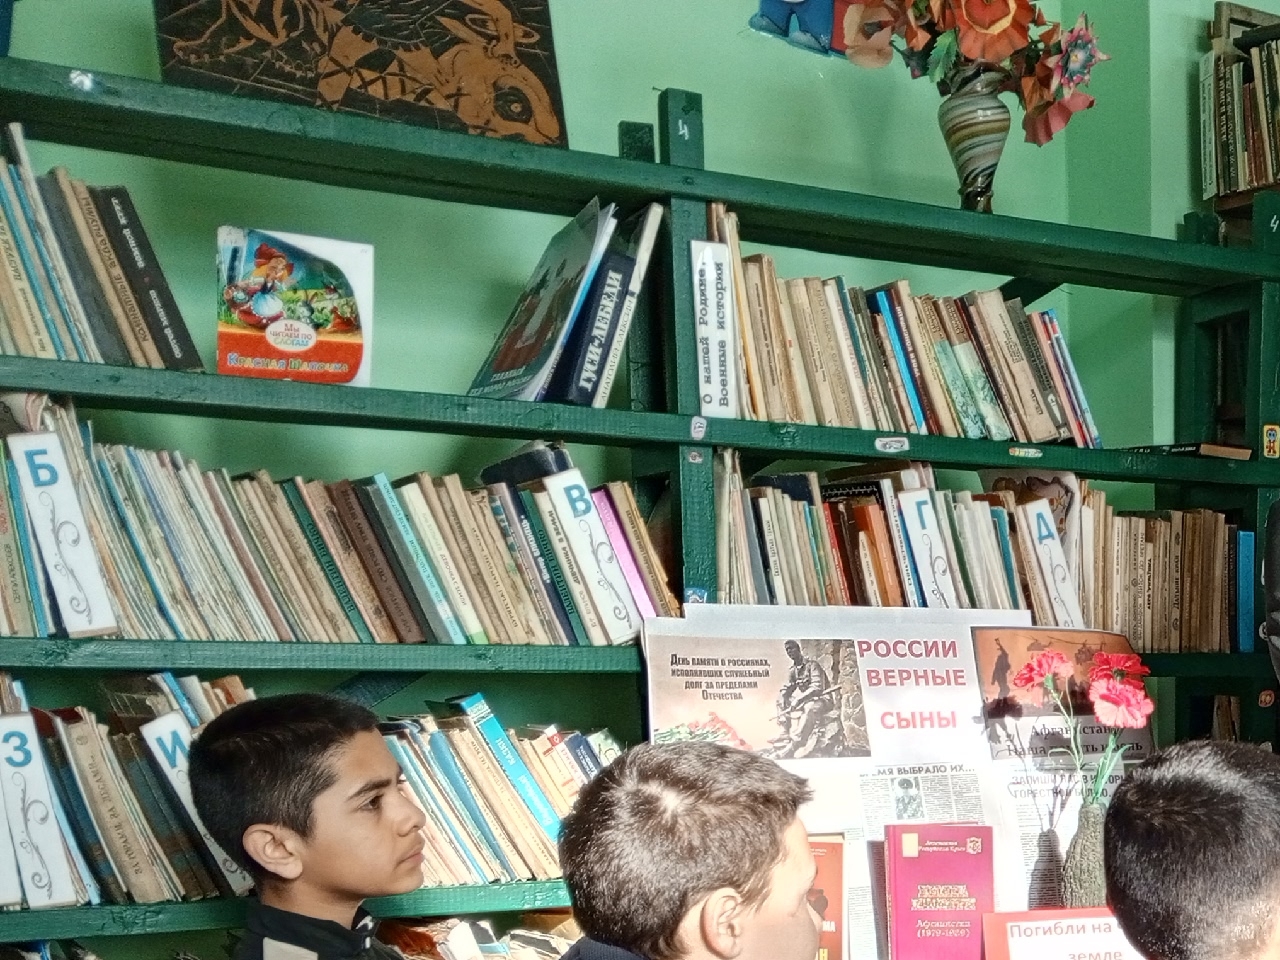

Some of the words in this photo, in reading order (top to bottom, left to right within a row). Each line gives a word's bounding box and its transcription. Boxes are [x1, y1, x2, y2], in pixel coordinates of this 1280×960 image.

[698, 262, 709, 326] Родине,
[714, 261, 726, 330] истории
[579, 269, 622, 392] ГУСИ-ЛЕБЕДИ
[699, 336, 712, 384] нашей
[718, 339, 729, 408] Военные
[703, 393, 713, 404] О
[23, 449, 59, 487] Б
[563, 484, 592, 518] В
[915, 499, 929, 530] Г
[1036, 512, 1055, 545] Д
[857, 640, 958, 658] РОССИИ
[866, 669, 966, 687] ВЕРНЫЕ
[880, 711, 957, 729] СЫНЫ
[2, 731, 33, 768] З
[494, 736, 517, 766] КАЗКИ
[897, 765, 947, 775] ВЫБРАЛО
[1009, 921, 1086, 938] Погибли
[1092, 922, 1112, 933] на
